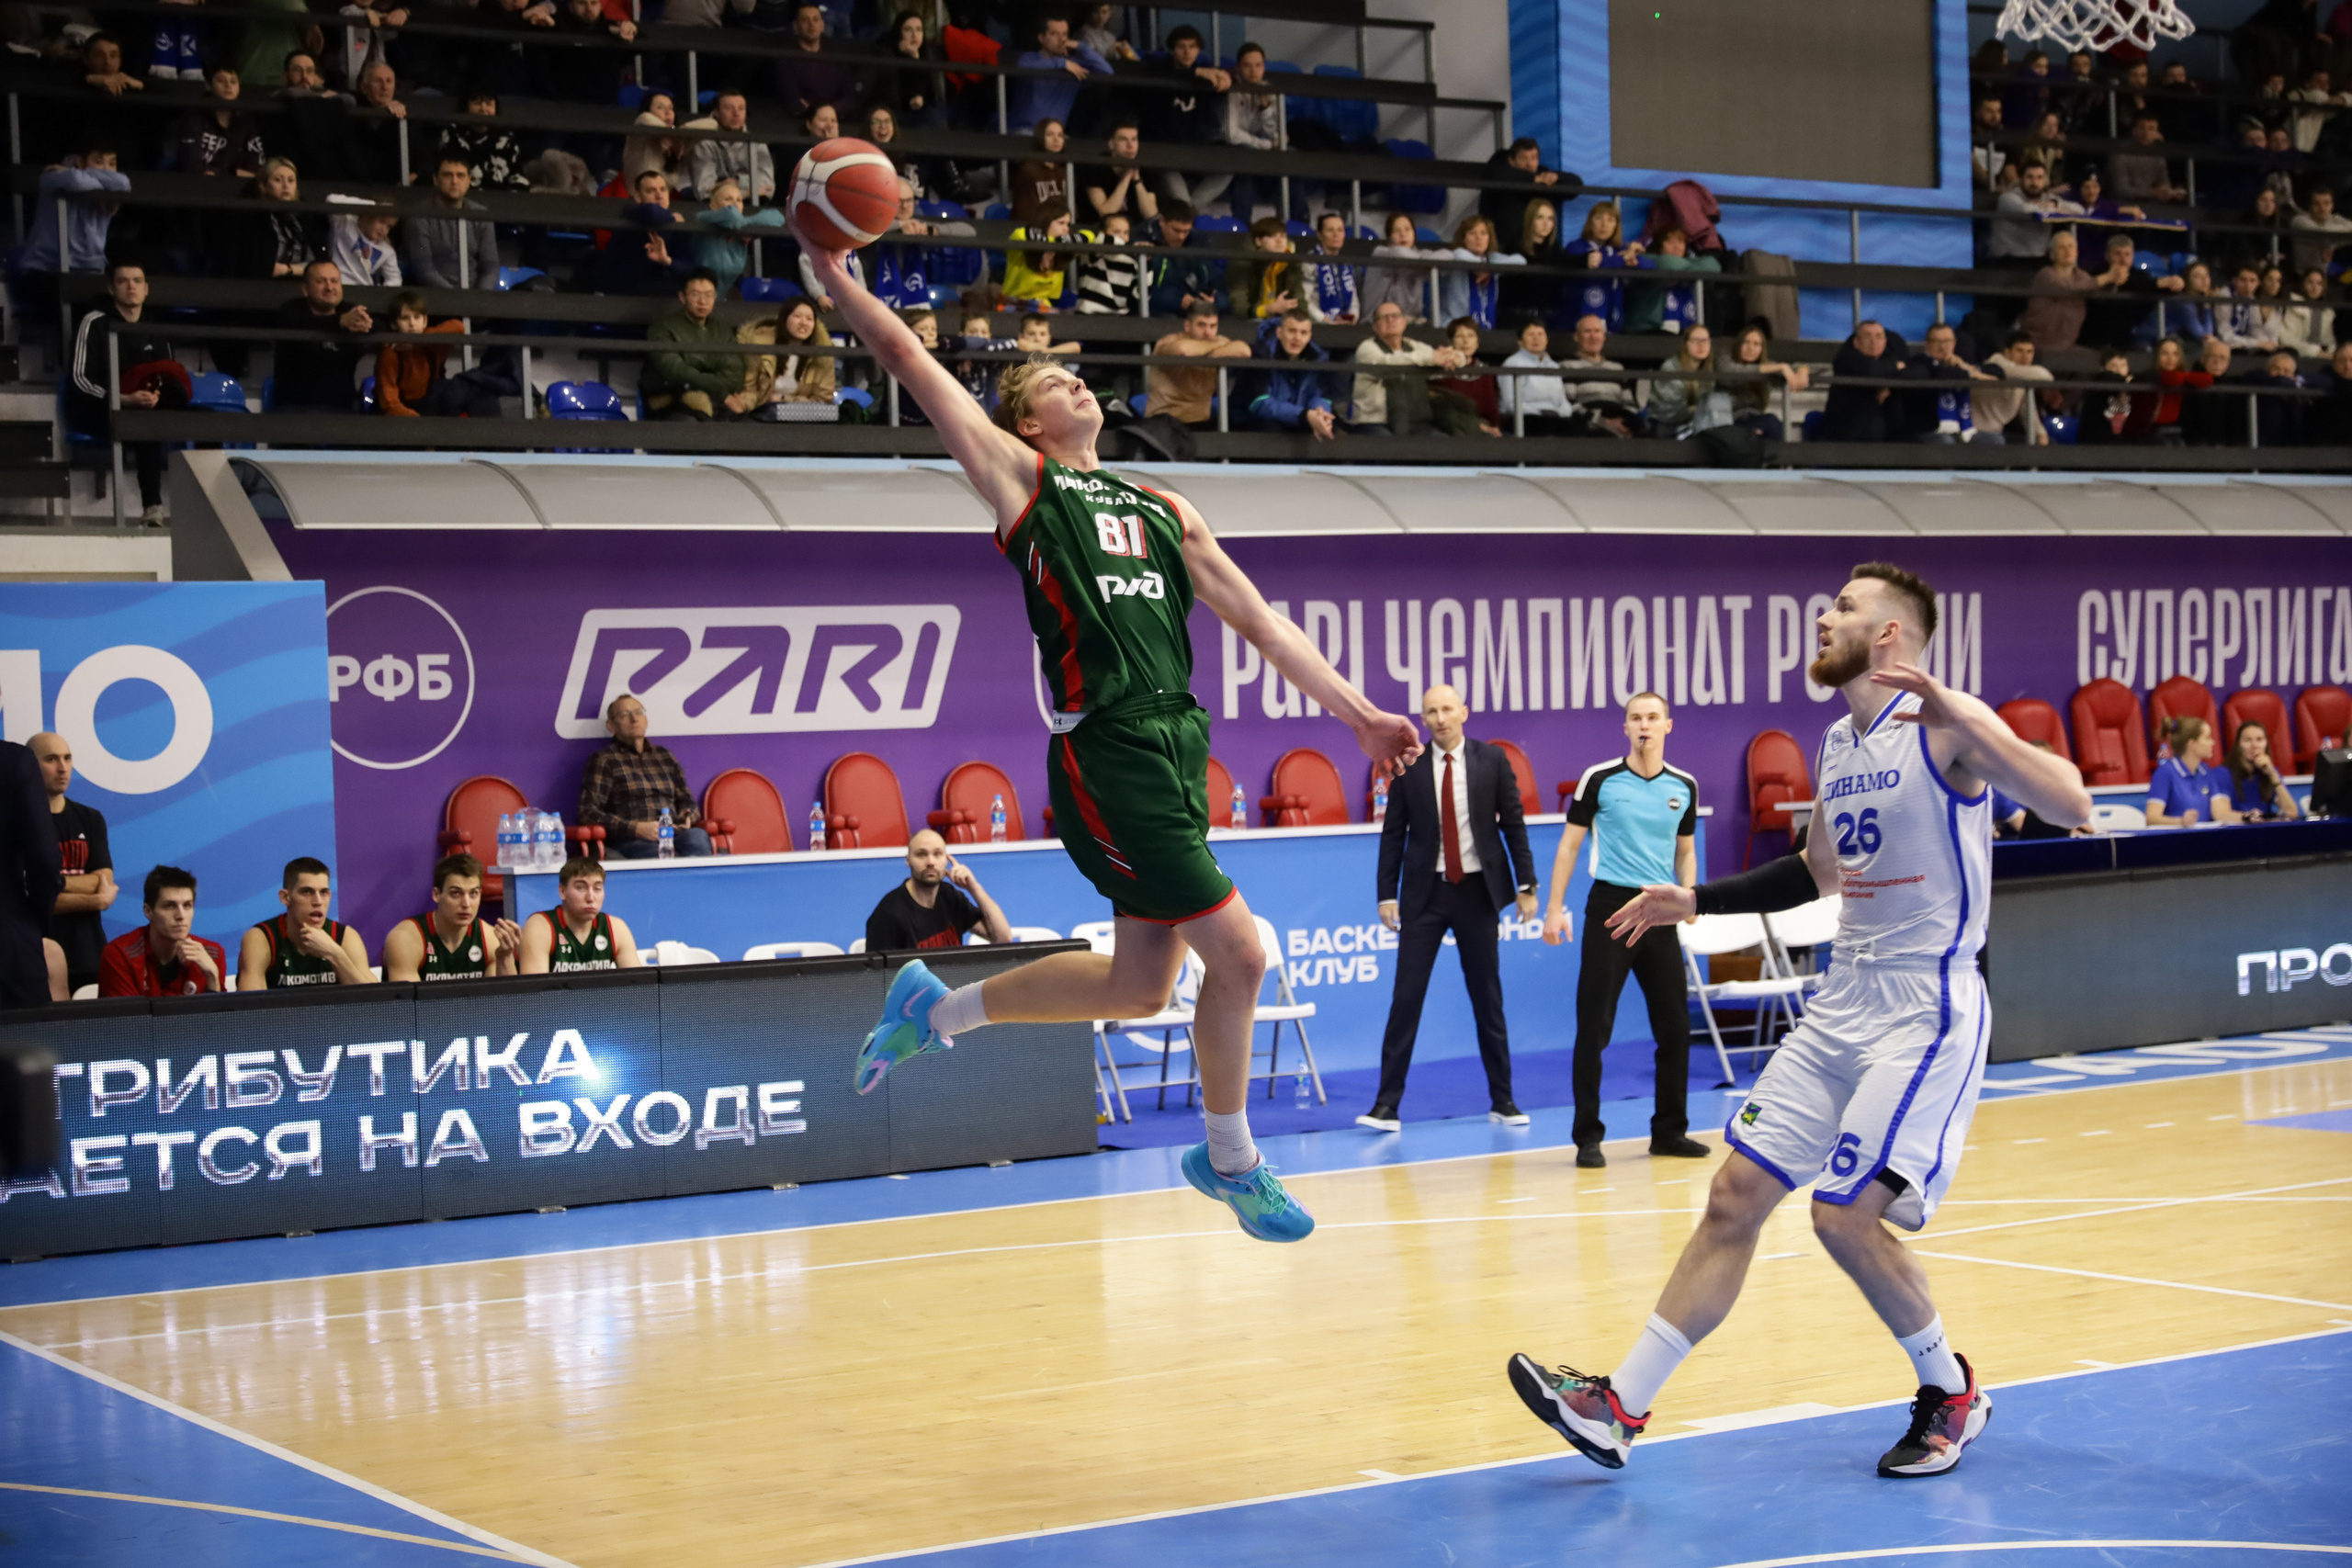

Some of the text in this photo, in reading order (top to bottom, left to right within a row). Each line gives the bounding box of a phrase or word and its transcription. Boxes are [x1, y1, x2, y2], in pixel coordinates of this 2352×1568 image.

[1095, 513, 1148, 558] 81
[327, 653, 453, 702] РФБ
[1823, 768, 1901, 802] ДИНАМО
[1834, 807, 1883, 855] 26
[1287, 953, 1380, 988] КЛУБ
[358, 1108, 490, 1171] НА
[518, 1079, 808, 1158] ВХОДЕ
